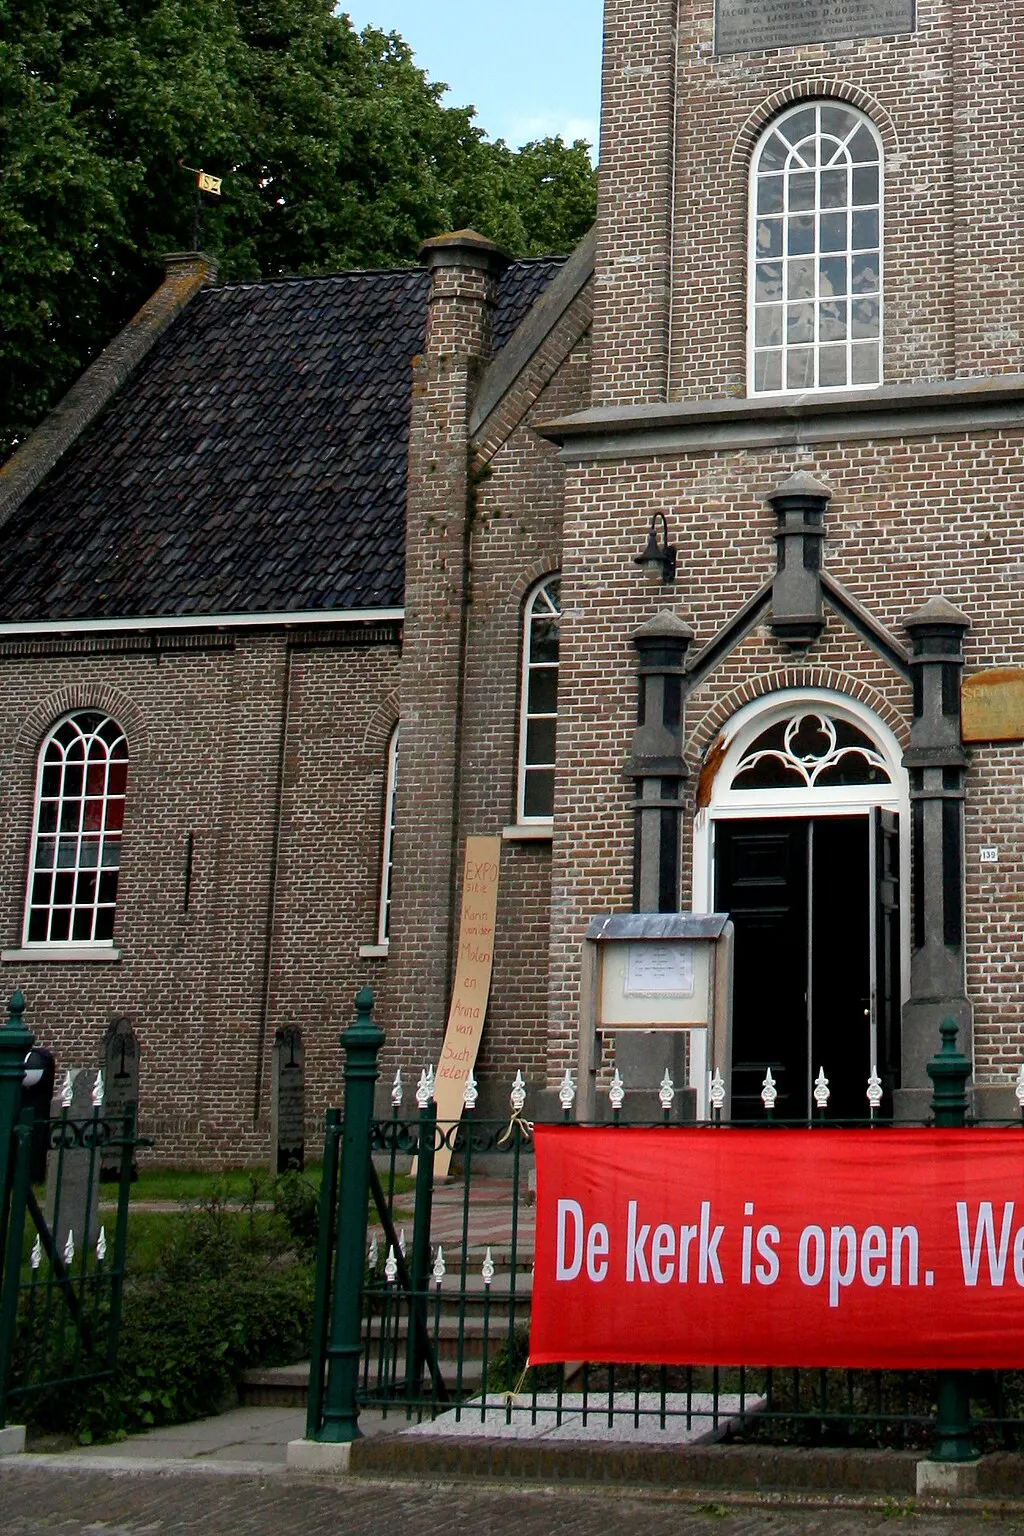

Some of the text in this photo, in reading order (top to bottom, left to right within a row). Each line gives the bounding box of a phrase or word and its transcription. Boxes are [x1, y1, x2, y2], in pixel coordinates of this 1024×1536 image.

[983, 851, 996, 859] 139
[466, 861, 498, 882] EXPO
[464, 906, 488, 921] Karin
[461, 943, 490, 963] Molen
[464, 977, 477, 988] en
[453, 999, 480, 1018] Anna
[456, 1023, 473, 1035] van
[556, 1199, 609, 1283] De
[626, 1201, 724, 1284] kerk
[742, 1203, 780, 1286] is
[799, 1225, 934, 1308] open.
